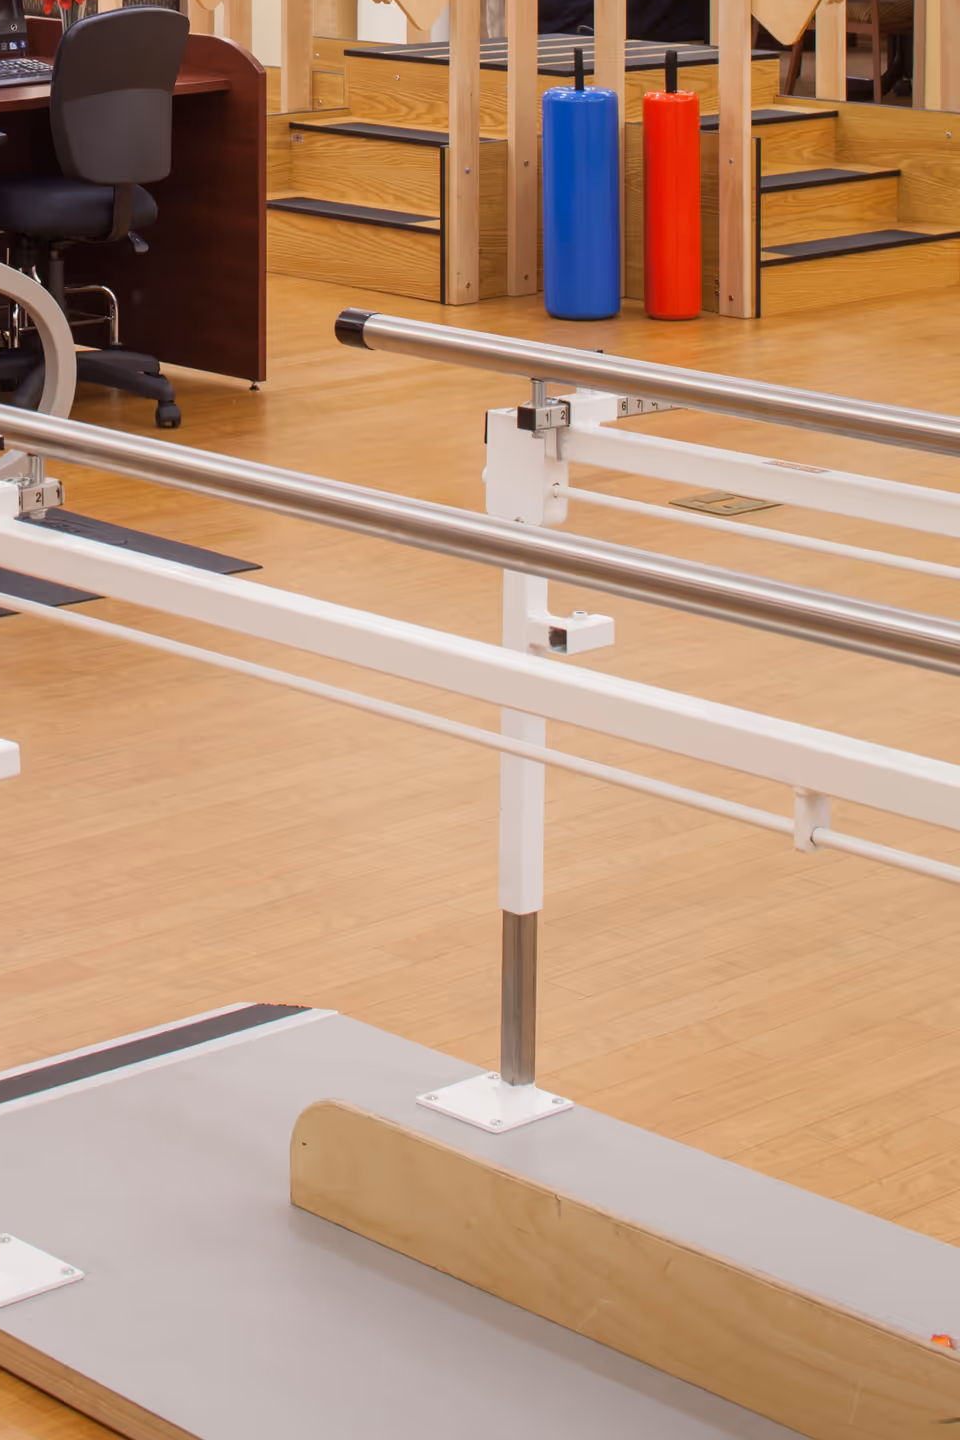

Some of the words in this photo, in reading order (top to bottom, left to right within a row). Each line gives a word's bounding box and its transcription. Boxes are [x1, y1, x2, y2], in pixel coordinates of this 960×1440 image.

[621, 401, 627, 411] 6
[636, 400, 641, 409] 7
[545, 412, 549, 423] 1
[560, 410, 566, 420] 2
[35, 492, 42, 503] 2
[55, 487, 60, 499] 1
